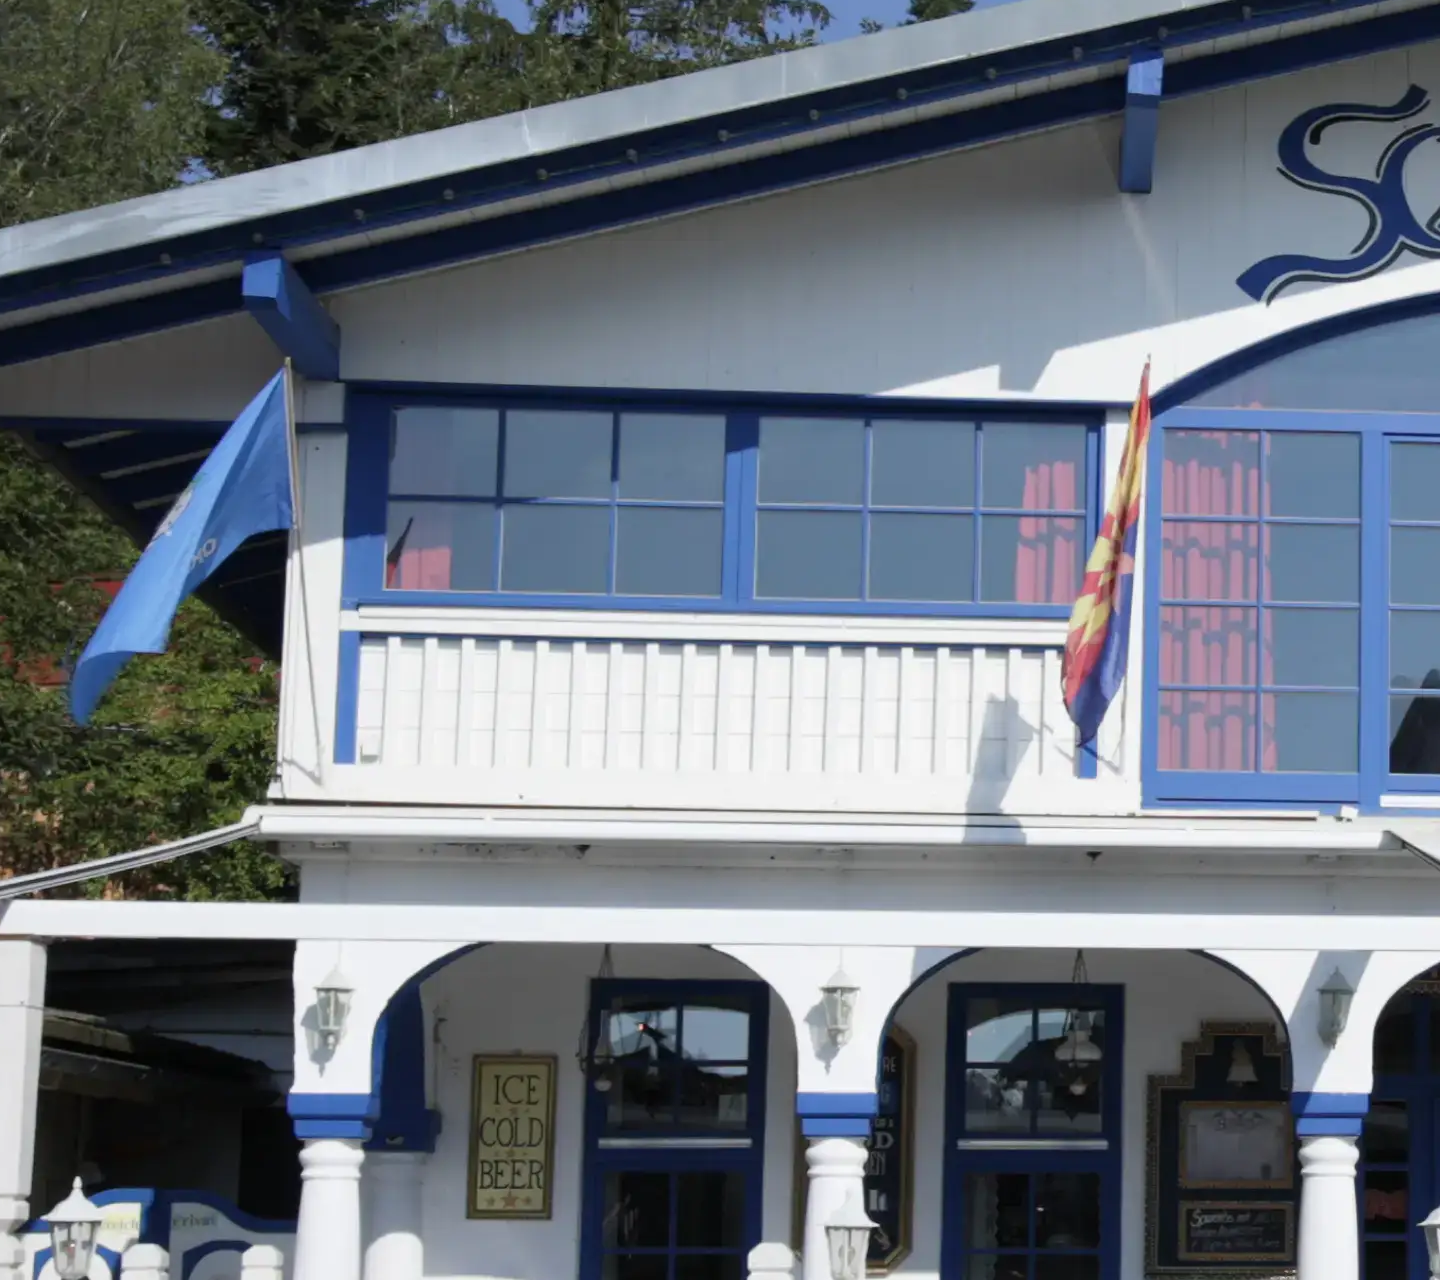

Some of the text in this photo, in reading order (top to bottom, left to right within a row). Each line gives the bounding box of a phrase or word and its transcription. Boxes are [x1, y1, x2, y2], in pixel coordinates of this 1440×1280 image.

[494, 1074, 541, 1106] ICE
[479, 1116, 544, 1148] COLD
[479, 1159, 544, 1190] BEER
